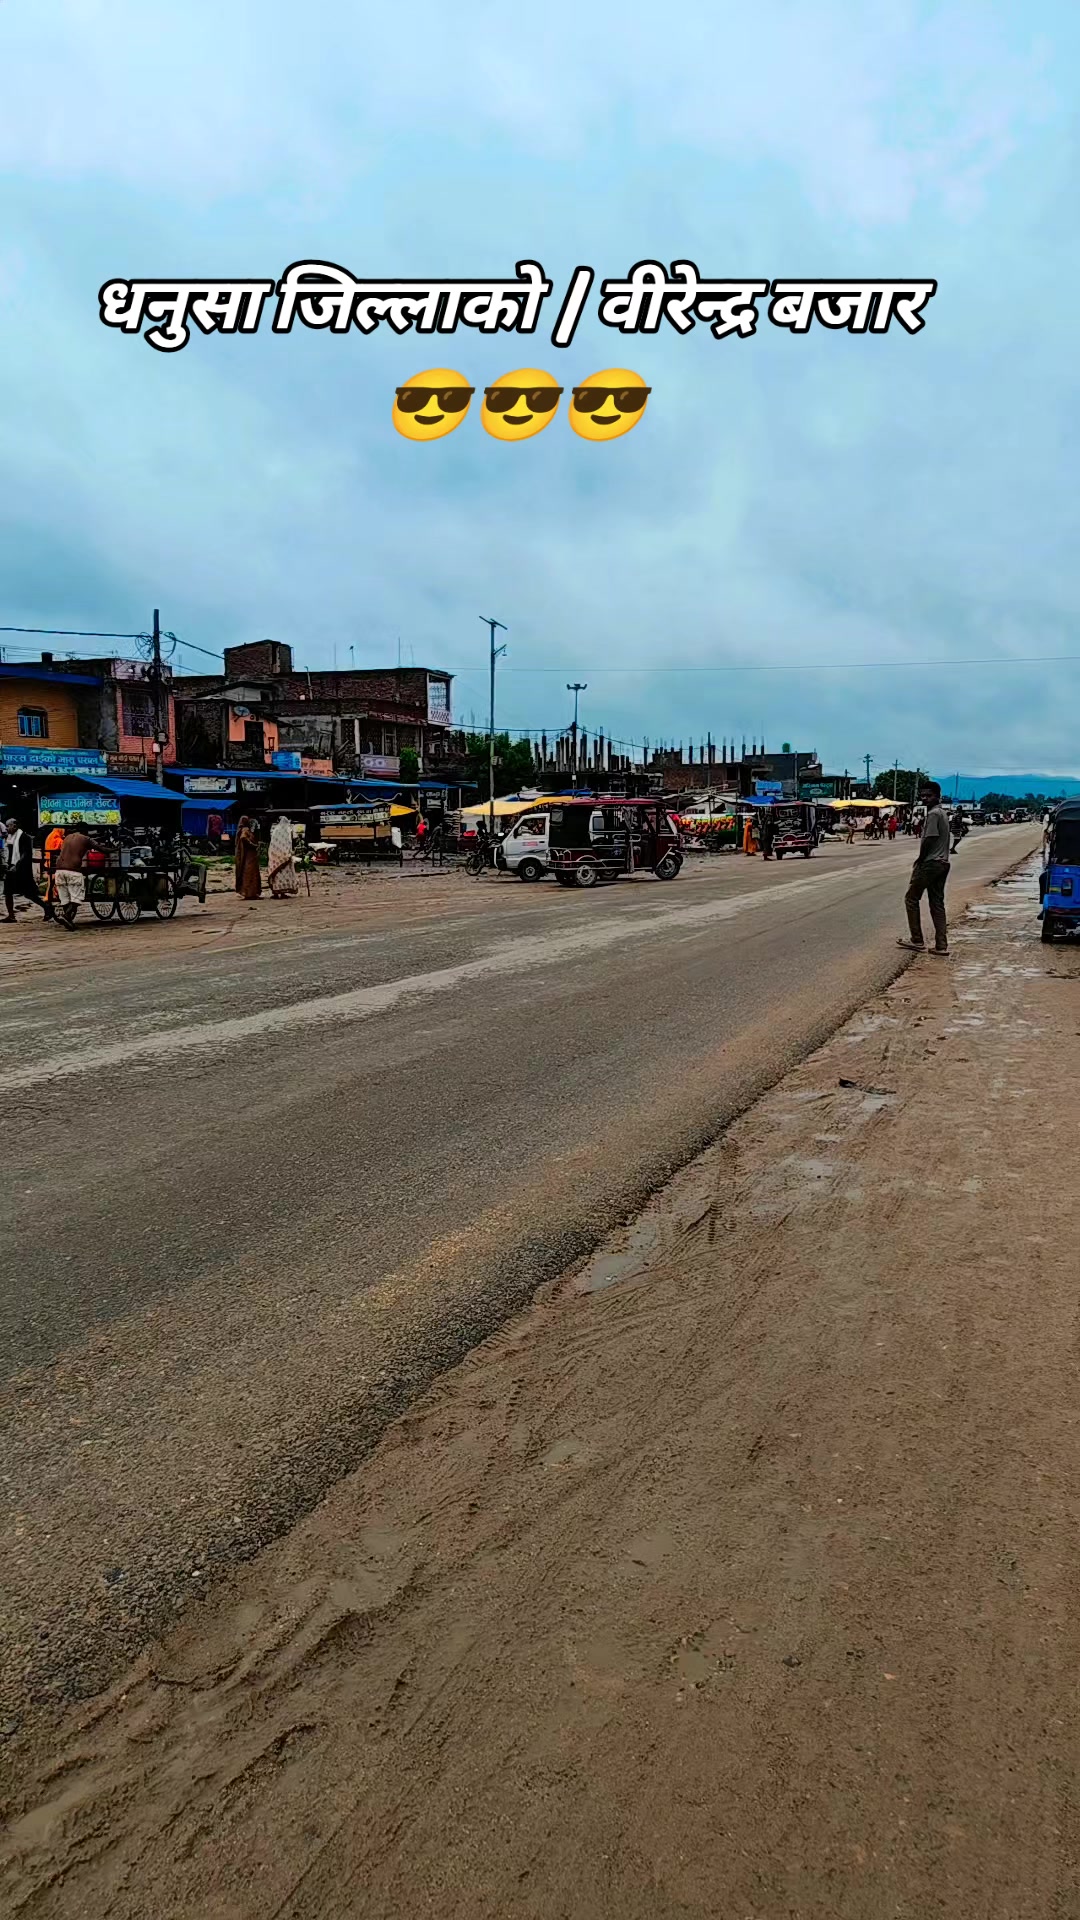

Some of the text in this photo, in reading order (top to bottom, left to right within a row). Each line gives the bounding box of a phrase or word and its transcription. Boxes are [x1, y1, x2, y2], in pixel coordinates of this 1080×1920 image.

[40, 795, 118, 809] शिवम चाउमिन सेन्टर
